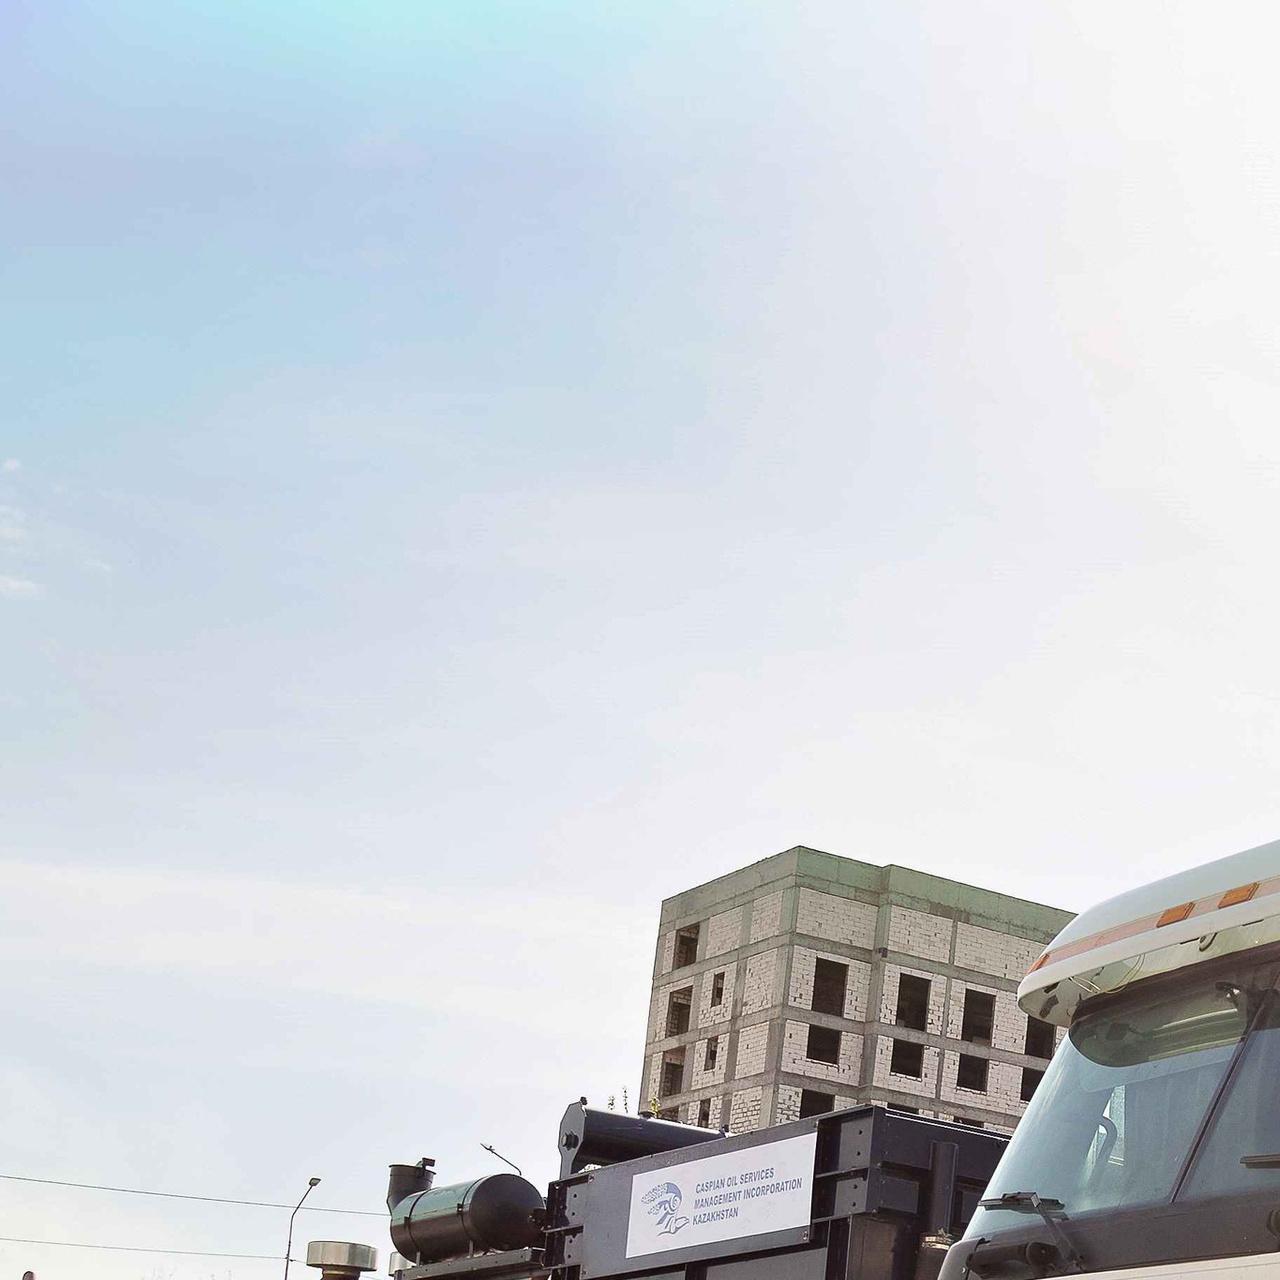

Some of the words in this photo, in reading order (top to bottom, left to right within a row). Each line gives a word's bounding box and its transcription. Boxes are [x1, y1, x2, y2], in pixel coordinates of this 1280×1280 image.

[694, 1190, 742, 1210] MANAGEMENT
[743, 1177, 803, 1200] INCORPORATION
[695, 1180, 725, 1194] CASPIAN
[726, 1175, 738, 1188] OIL
[739, 1167, 775, 1185] SERVICES
[692, 1206, 739, 1226] KAZAKHSTAN
